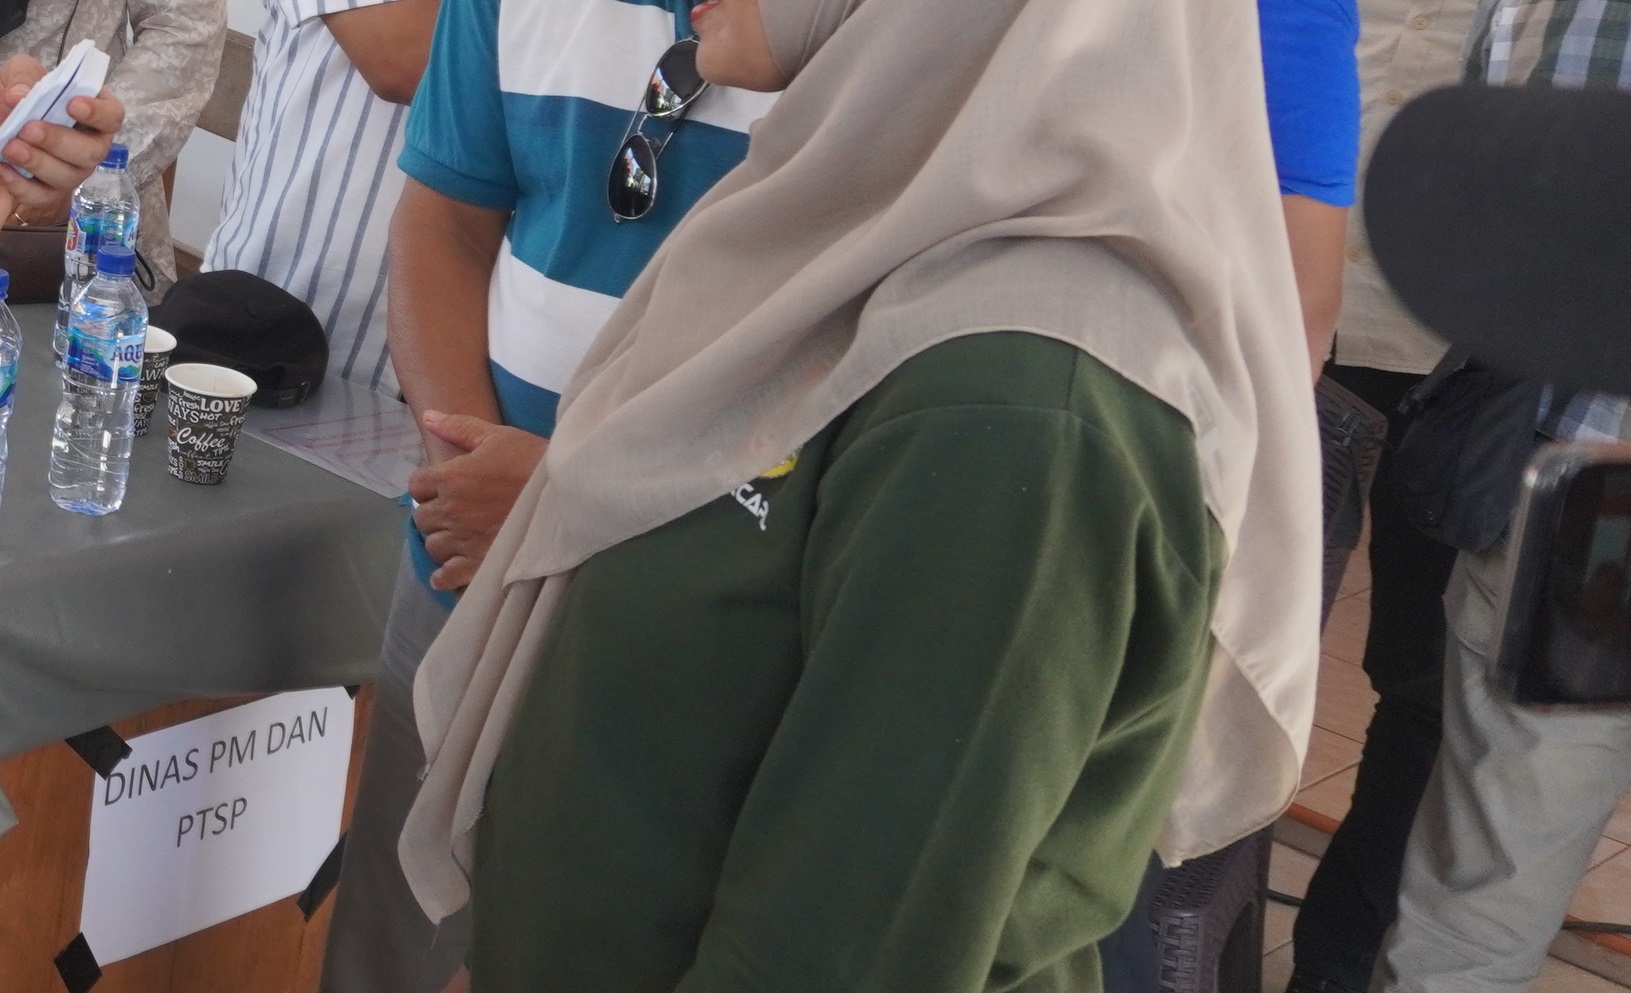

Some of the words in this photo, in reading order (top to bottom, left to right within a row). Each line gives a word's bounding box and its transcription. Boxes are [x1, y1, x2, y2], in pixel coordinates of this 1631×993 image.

[199, 412, 223, 421] HOT
[200, 397, 242, 413] LOVE
[176, 427, 226, 452] Coffee
[104, 748, 200, 806] DINAS
[209, 730, 257, 774] PM
[267, 706, 328, 756] DAN
[176, 797, 248, 848] PTSP
